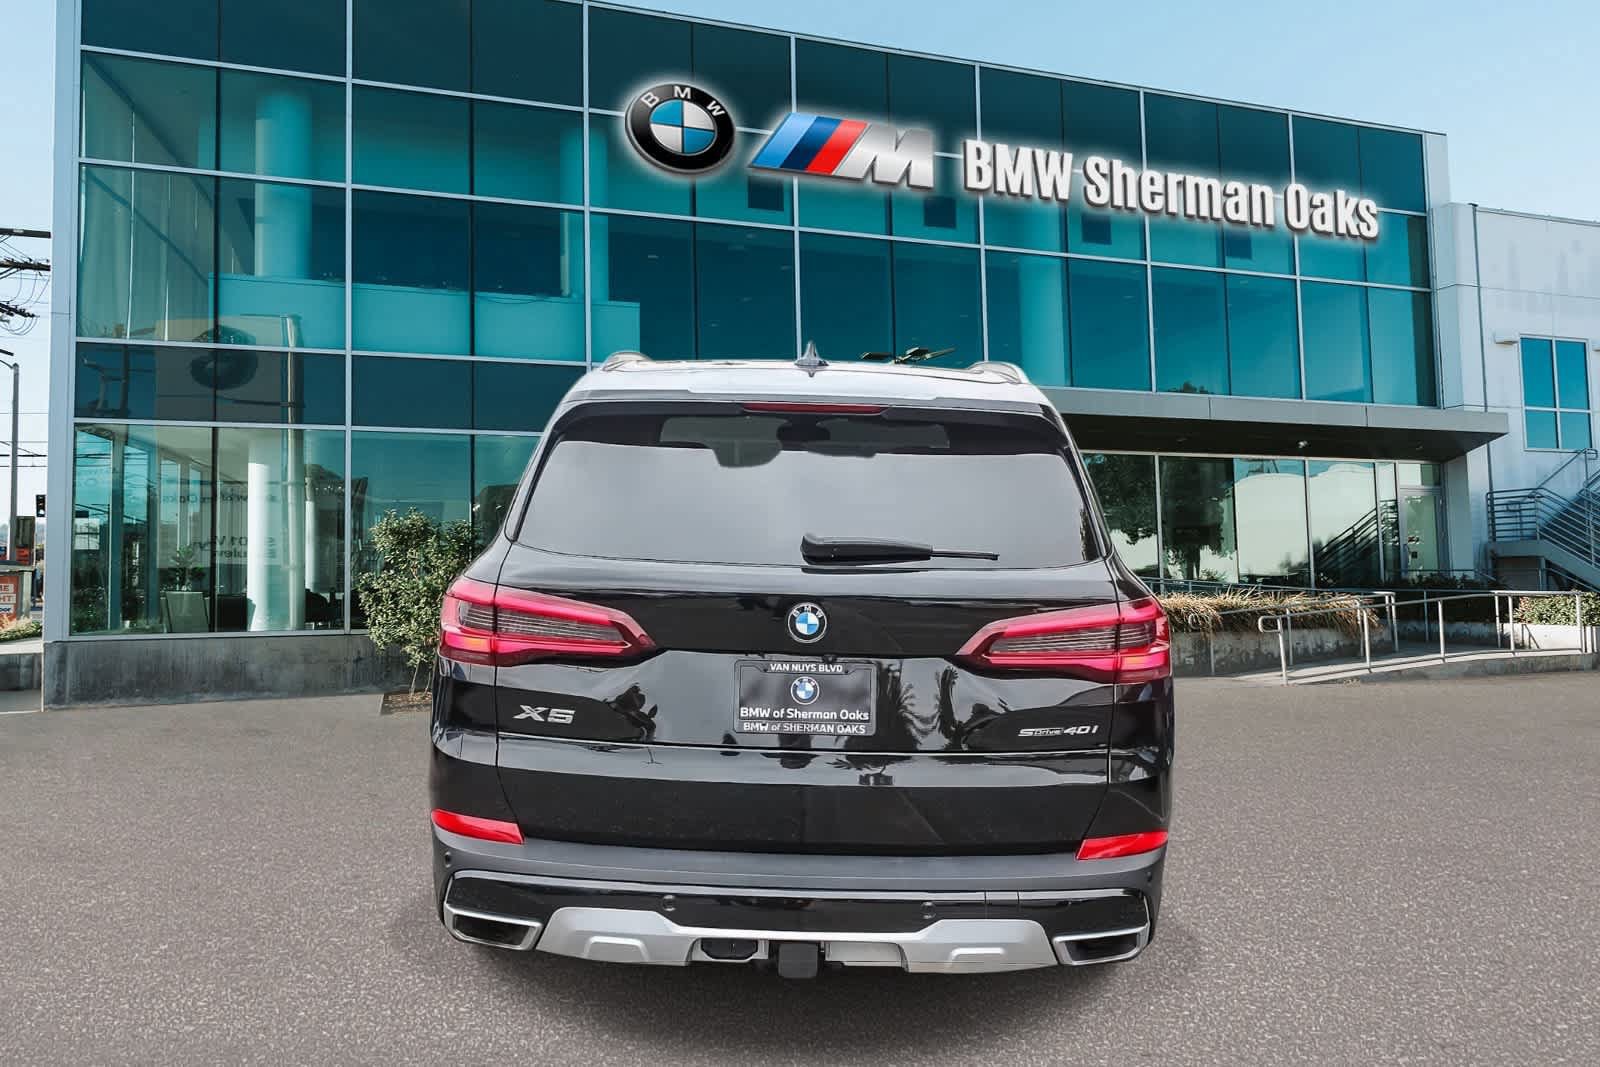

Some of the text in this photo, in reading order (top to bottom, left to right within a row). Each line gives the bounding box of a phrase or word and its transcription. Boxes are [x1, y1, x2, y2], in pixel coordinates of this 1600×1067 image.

[641, 84, 726, 117] BMW
[964, 139, 1380, 240] BMW Sherman Oaks
[770, 663, 843, 673] VAN NUYS BLVD
[512, 704, 576, 725] X5
[740, 707, 869, 721] BMW of Sherman Oaks
[743, 722, 769, 732] BMW
[784, 723, 834, 733] SHERMAN
[837, 724, 866, 734] OAKS
